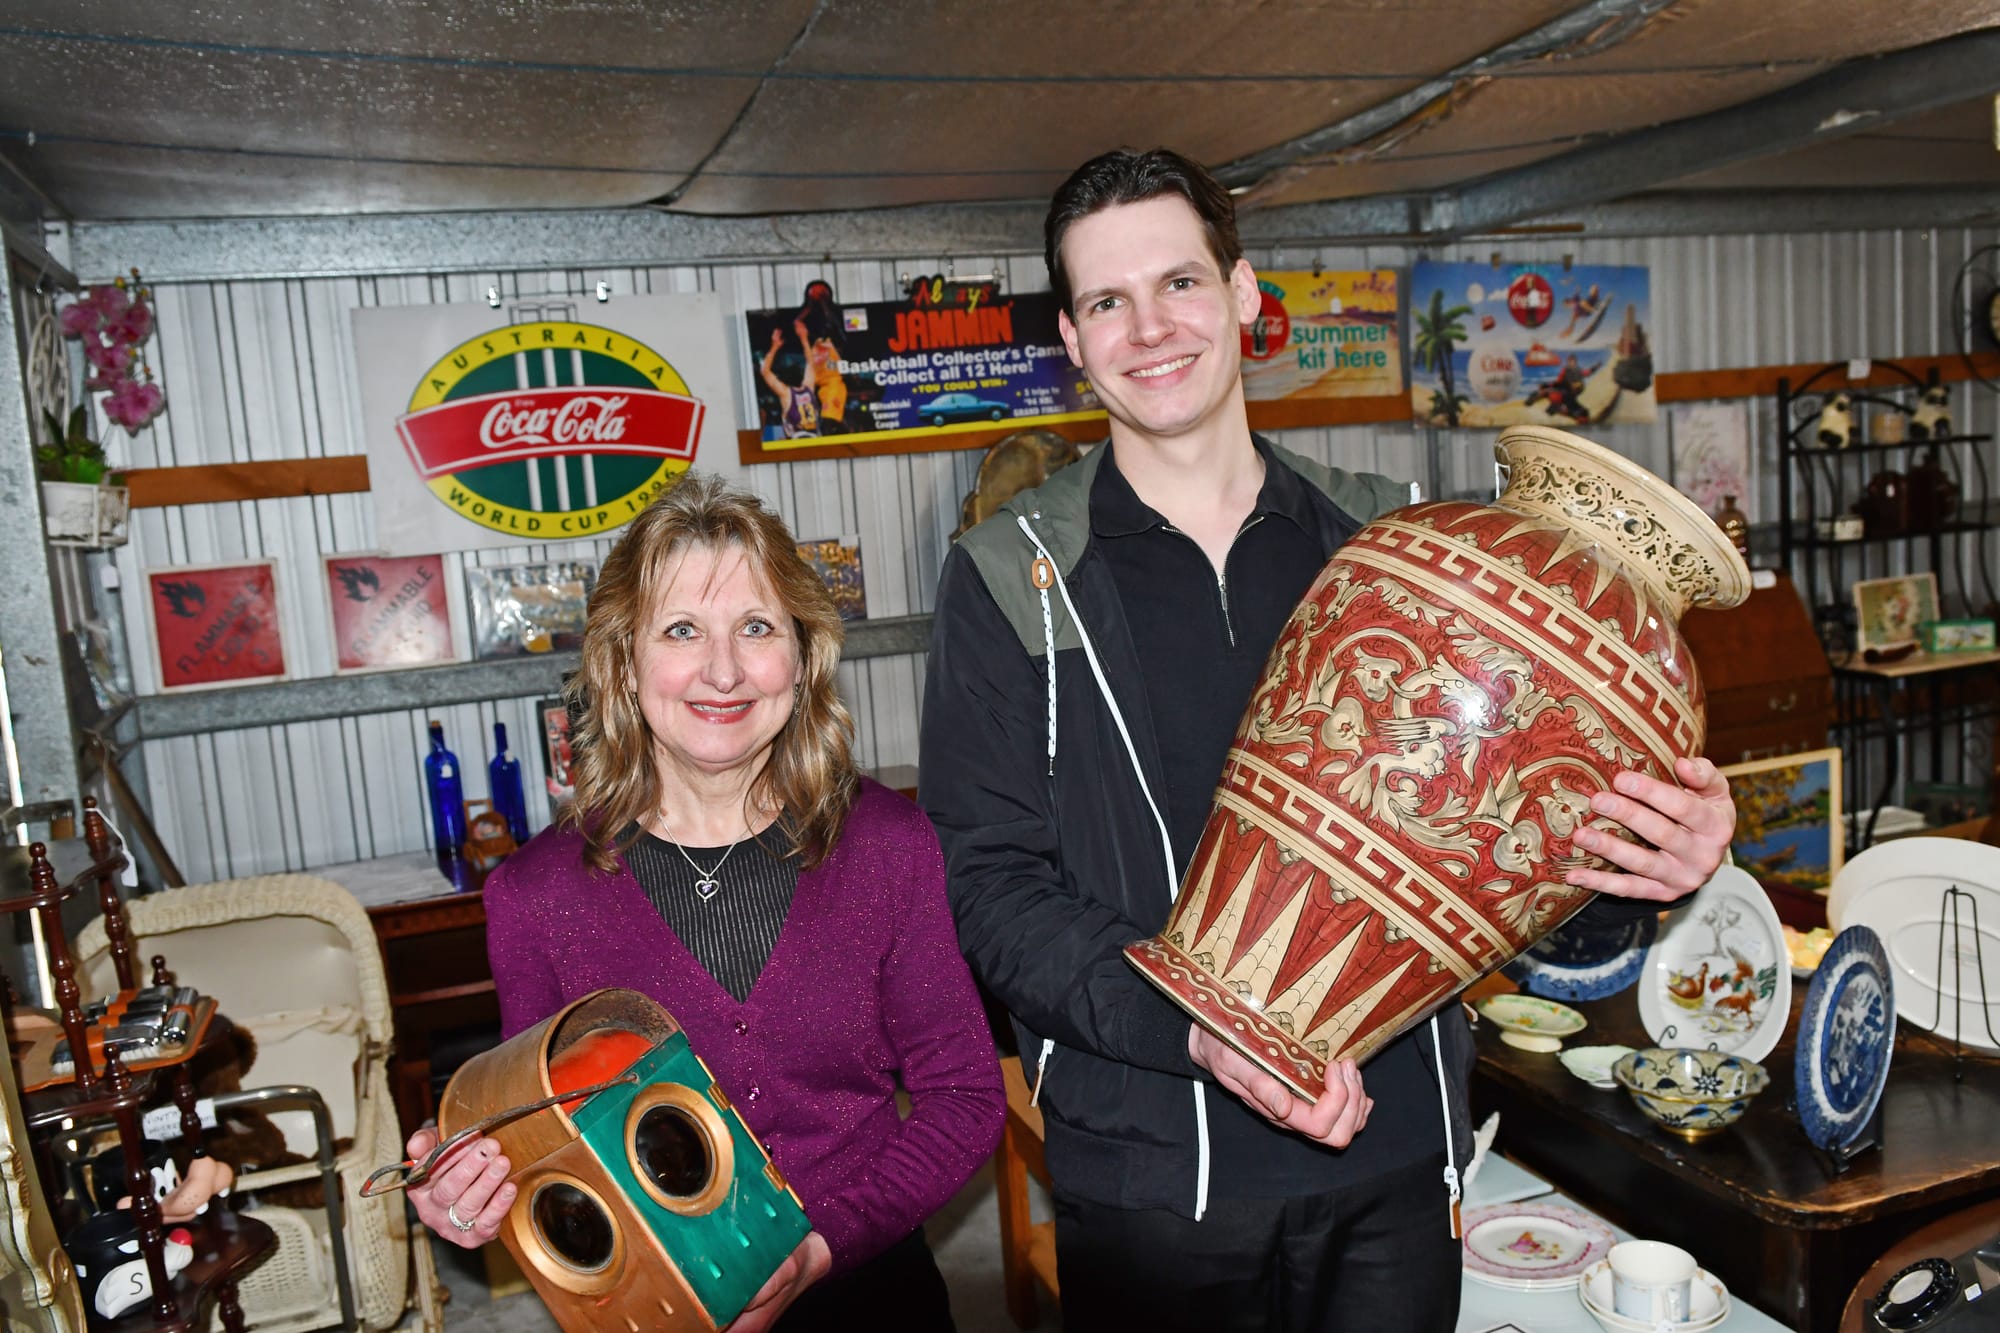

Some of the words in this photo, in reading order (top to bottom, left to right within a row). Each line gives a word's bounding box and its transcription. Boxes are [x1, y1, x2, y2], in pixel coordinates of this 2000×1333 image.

[1292, 325, 1390, 344] summer
[431, 329, 664, 392] AUSTRALIA
[838, 354, 928, 374] Basketball
[932, 348, 1021, 366] Collector's
[1298, 348, 1326, 369] kit
[1334, 346, 1387, 368] here
[875, 367, 935, 386] Collect
[940, 366, 960, 381] all
[966, 364, 986, 378] 12
[990, 360, 1033, 376] Here!
[944, 380, 977, 392] COULD
[480, 396, 630, 449] Coca-Cola
[449, 487, 542, 532] WORLD
[561, 511, 609, 532] CUP
[351, 566, 433, 658] FLAMMABLE
